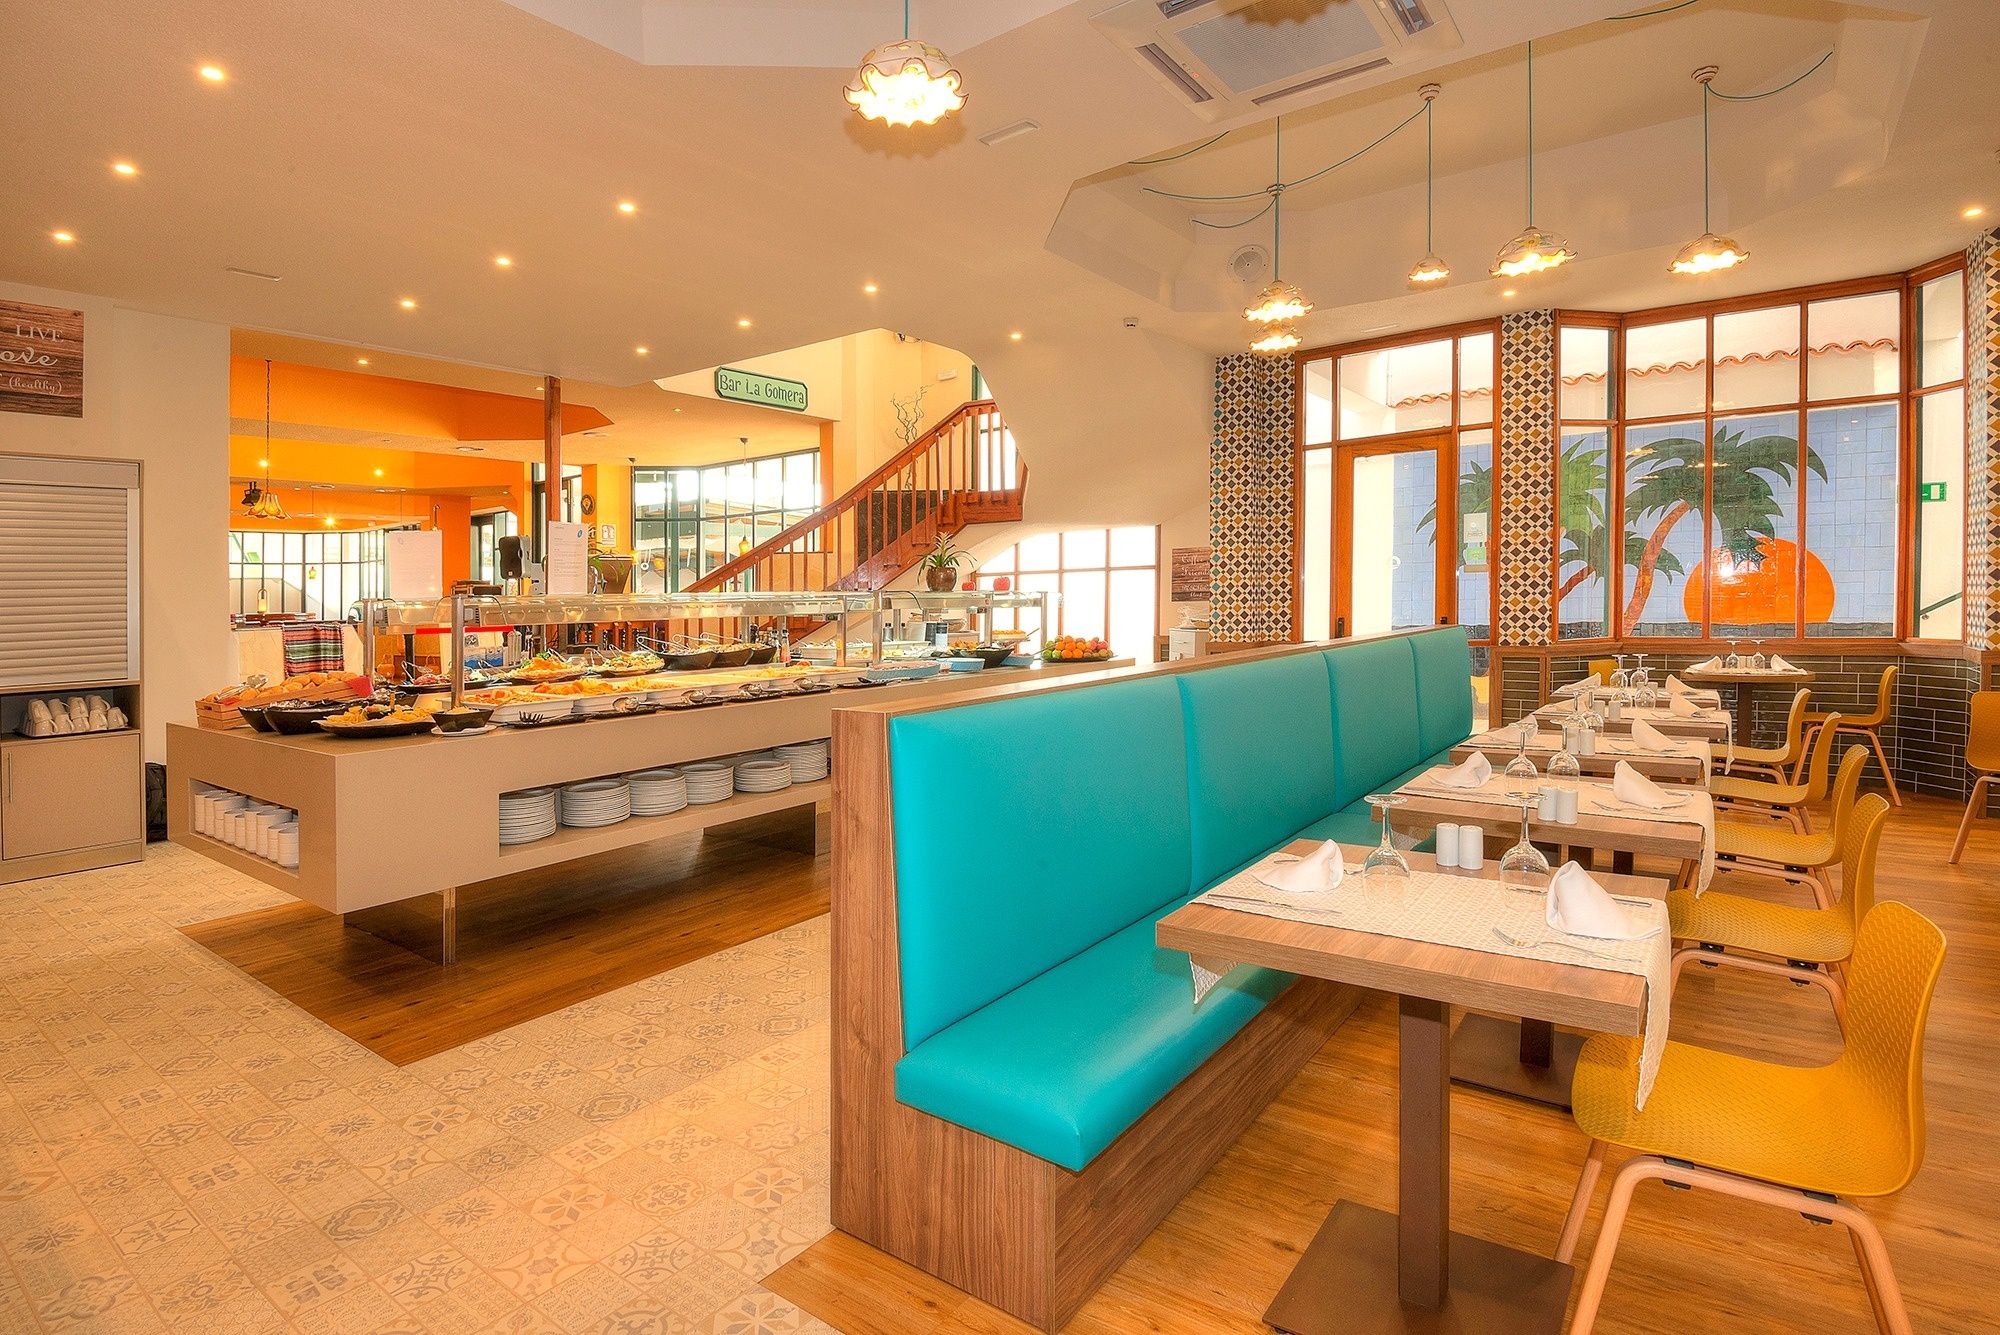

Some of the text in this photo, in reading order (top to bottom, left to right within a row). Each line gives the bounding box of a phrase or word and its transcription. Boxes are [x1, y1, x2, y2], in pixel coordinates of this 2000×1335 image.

[15, 324, 65, 342] LIVE
[719, 374, 805, 404] Bar La Gomera
